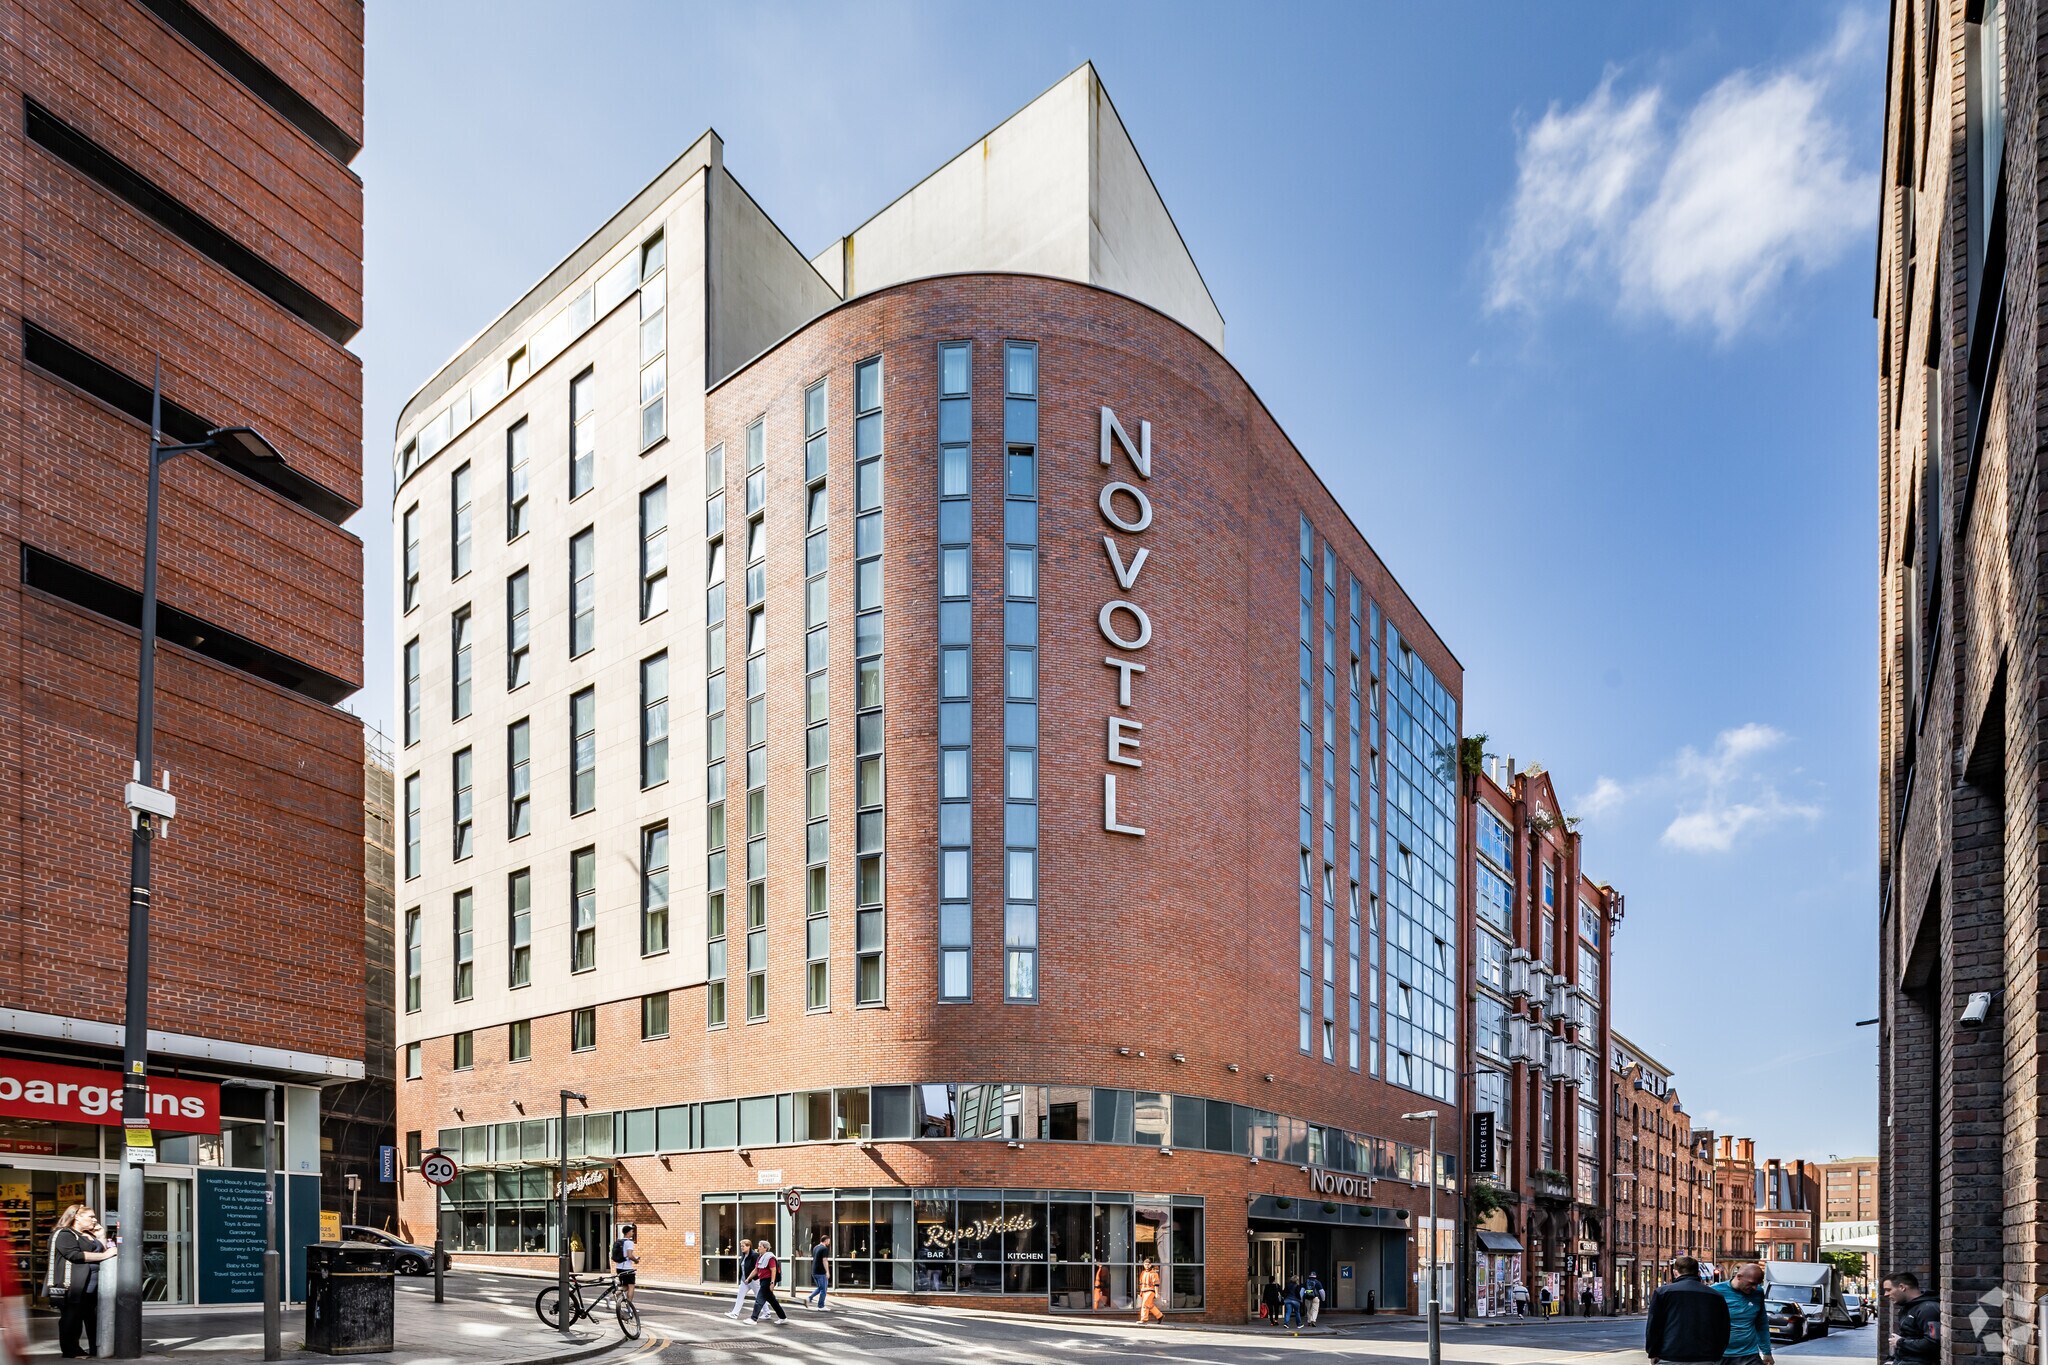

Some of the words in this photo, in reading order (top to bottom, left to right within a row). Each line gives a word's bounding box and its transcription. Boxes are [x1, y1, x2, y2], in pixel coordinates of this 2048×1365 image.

[1098, 405, 1153, 836] NOVOTEL
[427, 1162, 453, 1177] 20
[1312, 1168, 1376, 1198] NOVOTEL
[789, 1196, 799, 1207] 20
[1007, 1252, 1044, 1260] KITCHEN
